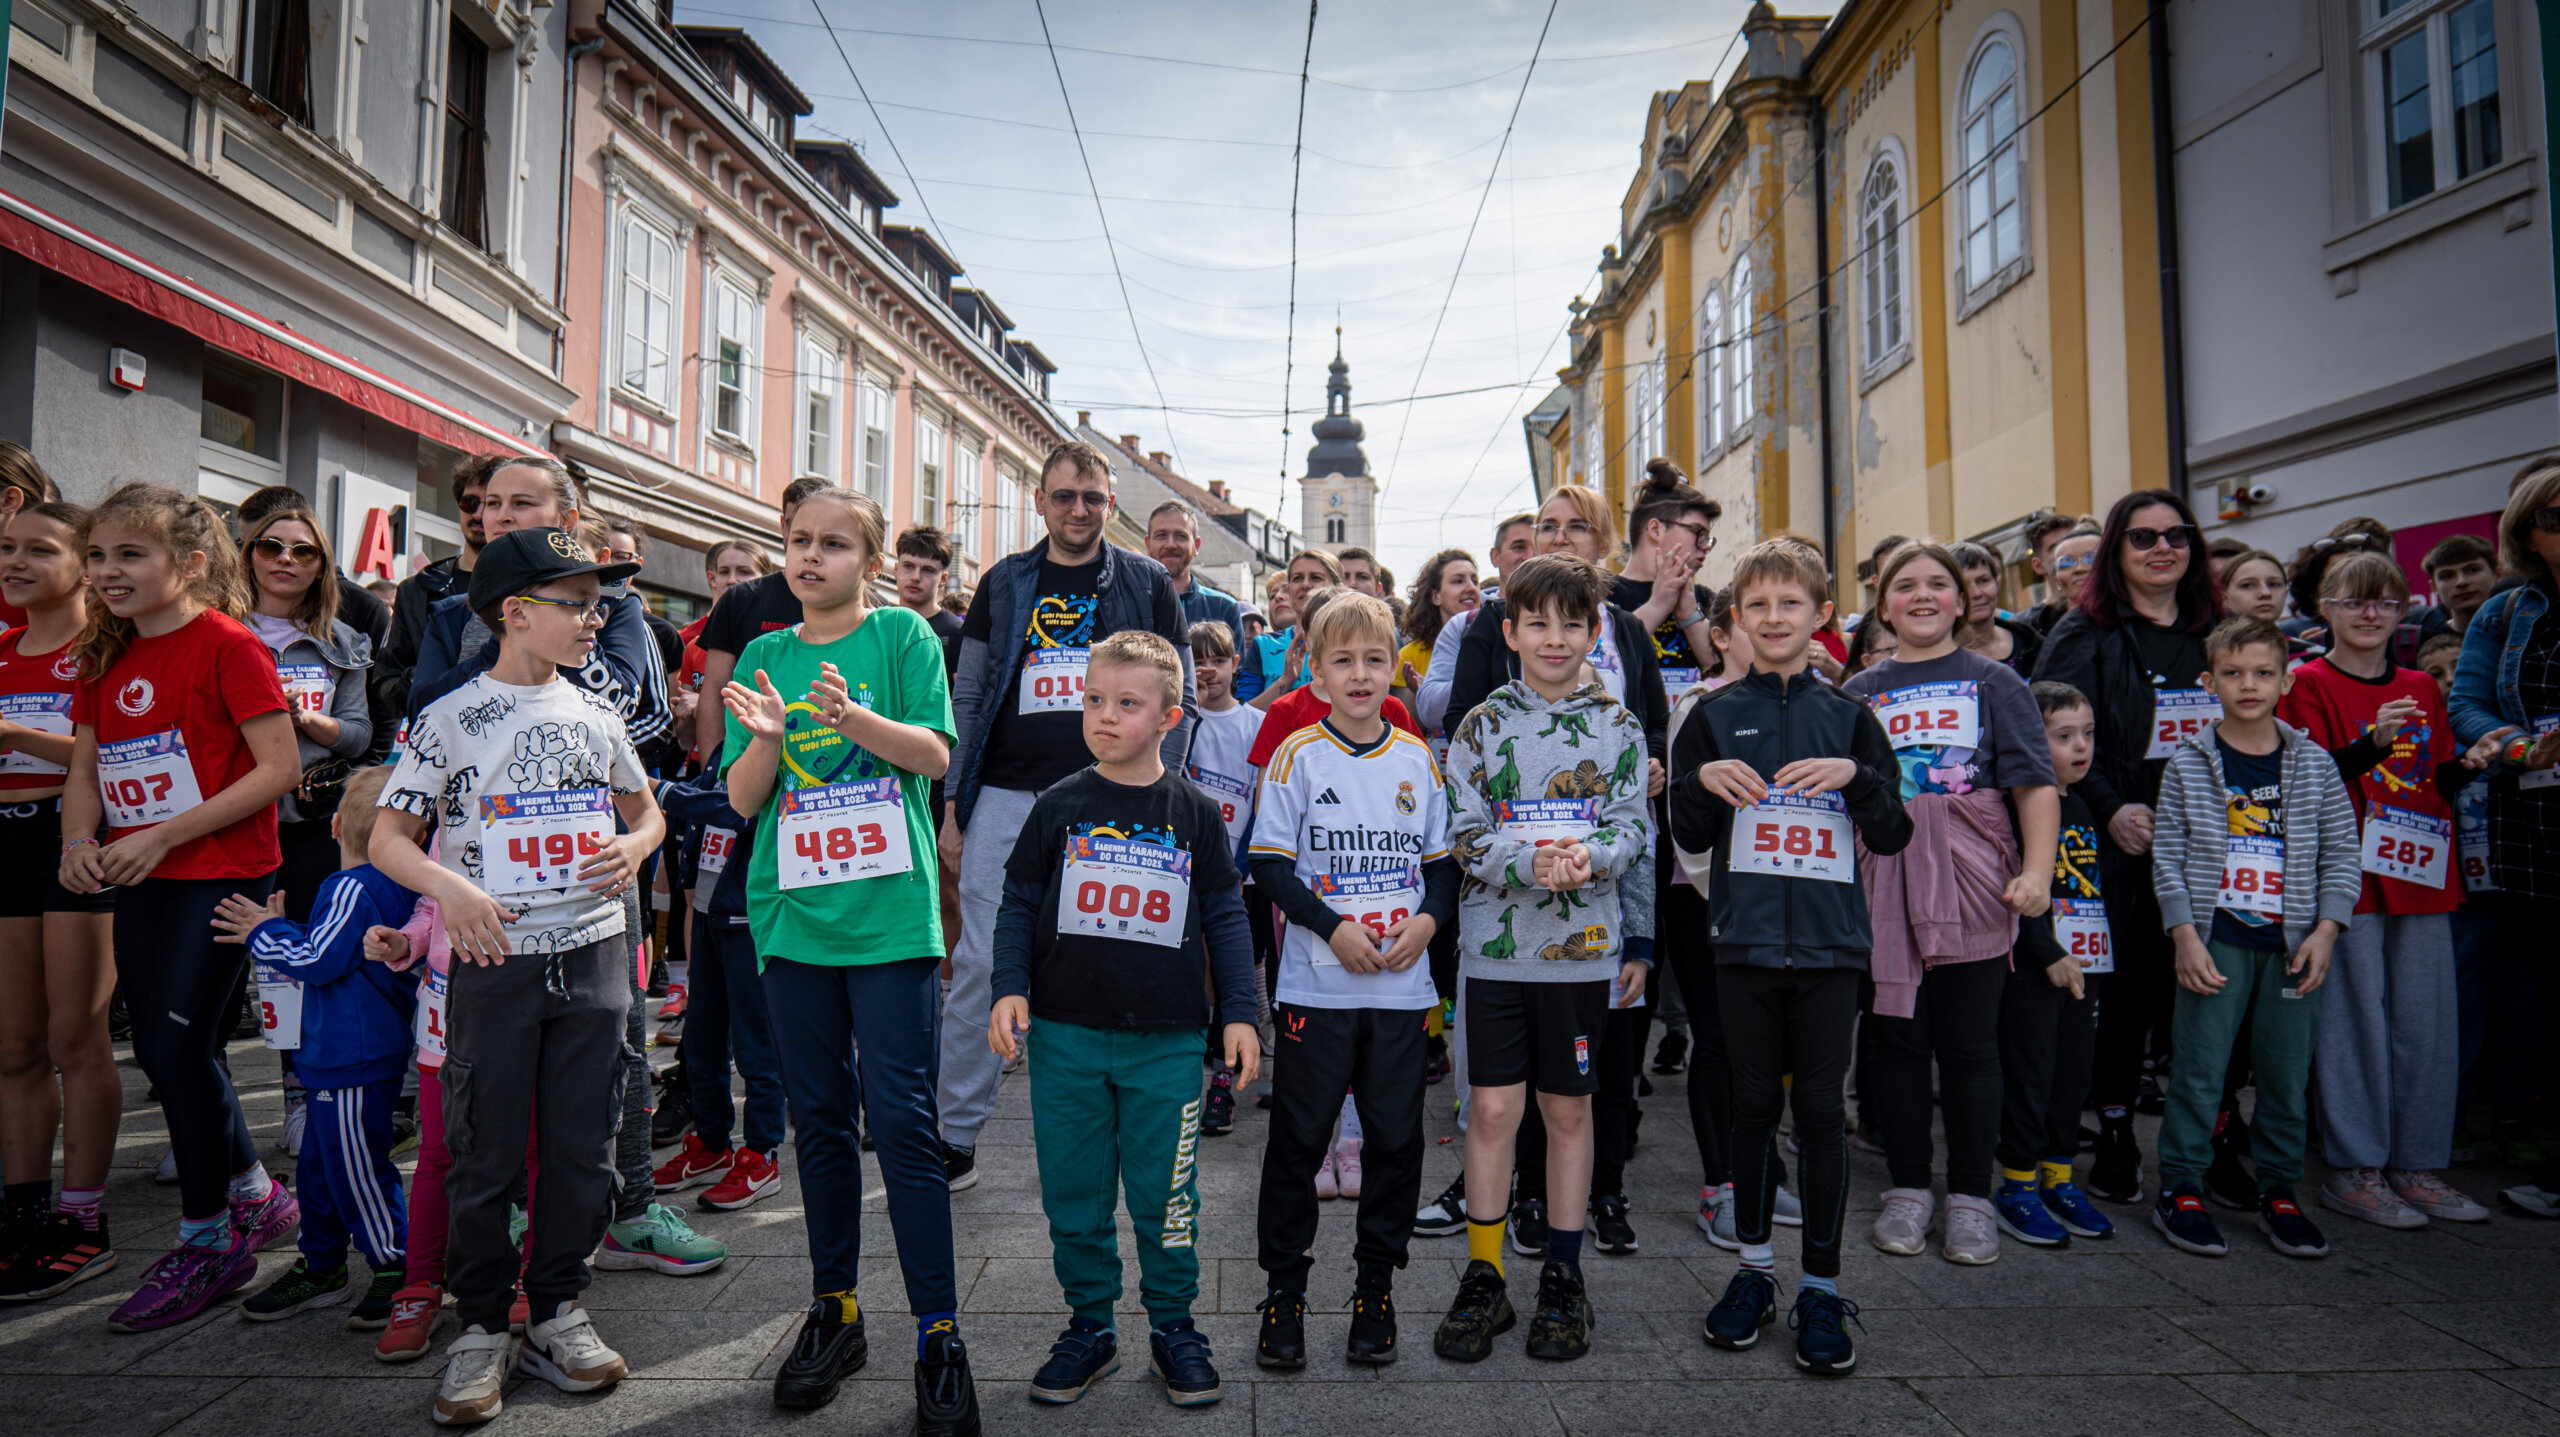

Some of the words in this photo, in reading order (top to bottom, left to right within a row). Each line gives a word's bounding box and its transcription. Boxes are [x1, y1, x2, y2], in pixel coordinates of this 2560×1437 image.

[353, 504, 407, 580] A1
[1062, 648, 1090, 656] ČARAPAM
[290, 688, 324, 711] 19
[1889, 709, 1960, 735] 012
[789, 731, 810, 743] BUDI
[812, 727, 837, 739] POSE
[799, 742, 819, 752] BUDI
[821, 735, 843, 747] COOL
[112, 738, 157, 752] ČARAPAMA
[126, 750, 150, 760] 2025.
[508, 752, 604, 793] YORK
[1965, 764, 1980, 779] HA
[104, 772, 173, 808] 407
[516, 795, 552, 807] ŠARENIM
[555, 792, 595, 803] ČARAPAMA
[799, 791, 826, 802] ŠARENIM
[829, 782, 877, 797] ČARAPAMA
[2252, 785, 2280, 800] SEEK
[524, 806, 538, 815] DO
[541, 804, 565, 814] CILJA
[568, 802, 589, 812] 2025.
[805, 802, 815, 811] DO
[818, 799, 841, 809] CILJA
[844, 794, 869, 806] 2025.
[1218, 801, 1235, 822] 8
[1512, 802, 1538, 812] ŠARENIM
[1541, 800, 1582, 810] ČARAPAMA
[1770, 796, 1781, 804] DO
[1784, 797, 1808, 806] CILJA
[1811, 800, 1830, 809] 2025.
[1518, 812, 1527, 820] DO
[1530, 811, 1550, 820] CILJA
[1553, 811, 1575, 819] 2025.
[2269, 822, 2285, 834] TU
[795, 822, 888, 863] 483
[1309, 824, 1423, 855] Emirates
[1754, 823, 1837, 859] 581
[508, 831, 601, 868] 494
[1094, 841, 1126, 854] ŠARENIM
[1129, 844, 1174, 861] ČARAPAMA
[2377, 835, 2435, 868] 287
[1100, 852, 1112, 861] DO
[1114, 854, 1138, 865] CILJA
[1141, 857, 1164, 870] 2025.
[1330, 856, 1354, 874] FLY
[2465, 857, 2488, 878] 8
[1337, 874, 1367, 885] ŠARENIM
[1370, 870, 1406, 884] ČARAPAMA
[1344, 884, 1355, 894] DO
[1358, 883, 1380, 892] CILJA
[1382, 880, 1400, 890] 2025.
[1077, 881, 1171, 923] 008
[2072, 932, 2108, 956] 260
[432, 972, 448, 986] ŠARENI
[261, 1001, 277, 1029] 3
[428, 1006, 443, 1038] 1
[1170, 1097, 1200, 1191] URBAN
